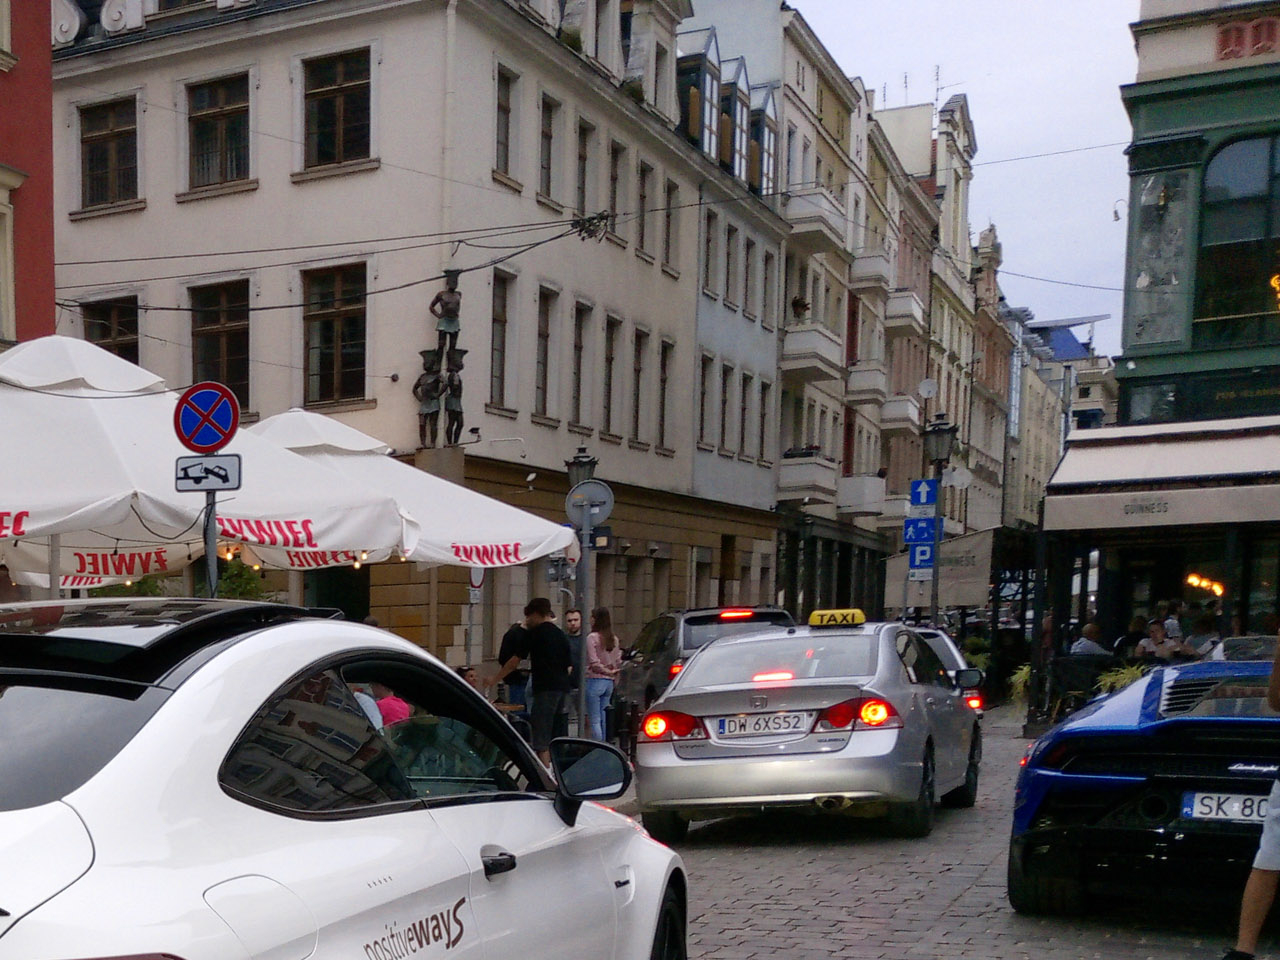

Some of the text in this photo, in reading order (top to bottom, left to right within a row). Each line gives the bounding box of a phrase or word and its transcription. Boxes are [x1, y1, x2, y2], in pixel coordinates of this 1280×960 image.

[451, 542, 528, 566] ŻYWIEC
[915, 546, 931, 566] P
[817, 613, 856, 624] TAXI
[728, 715, 801, 733] DW 6XS52
[1200, 796, 1231, 816] SK
